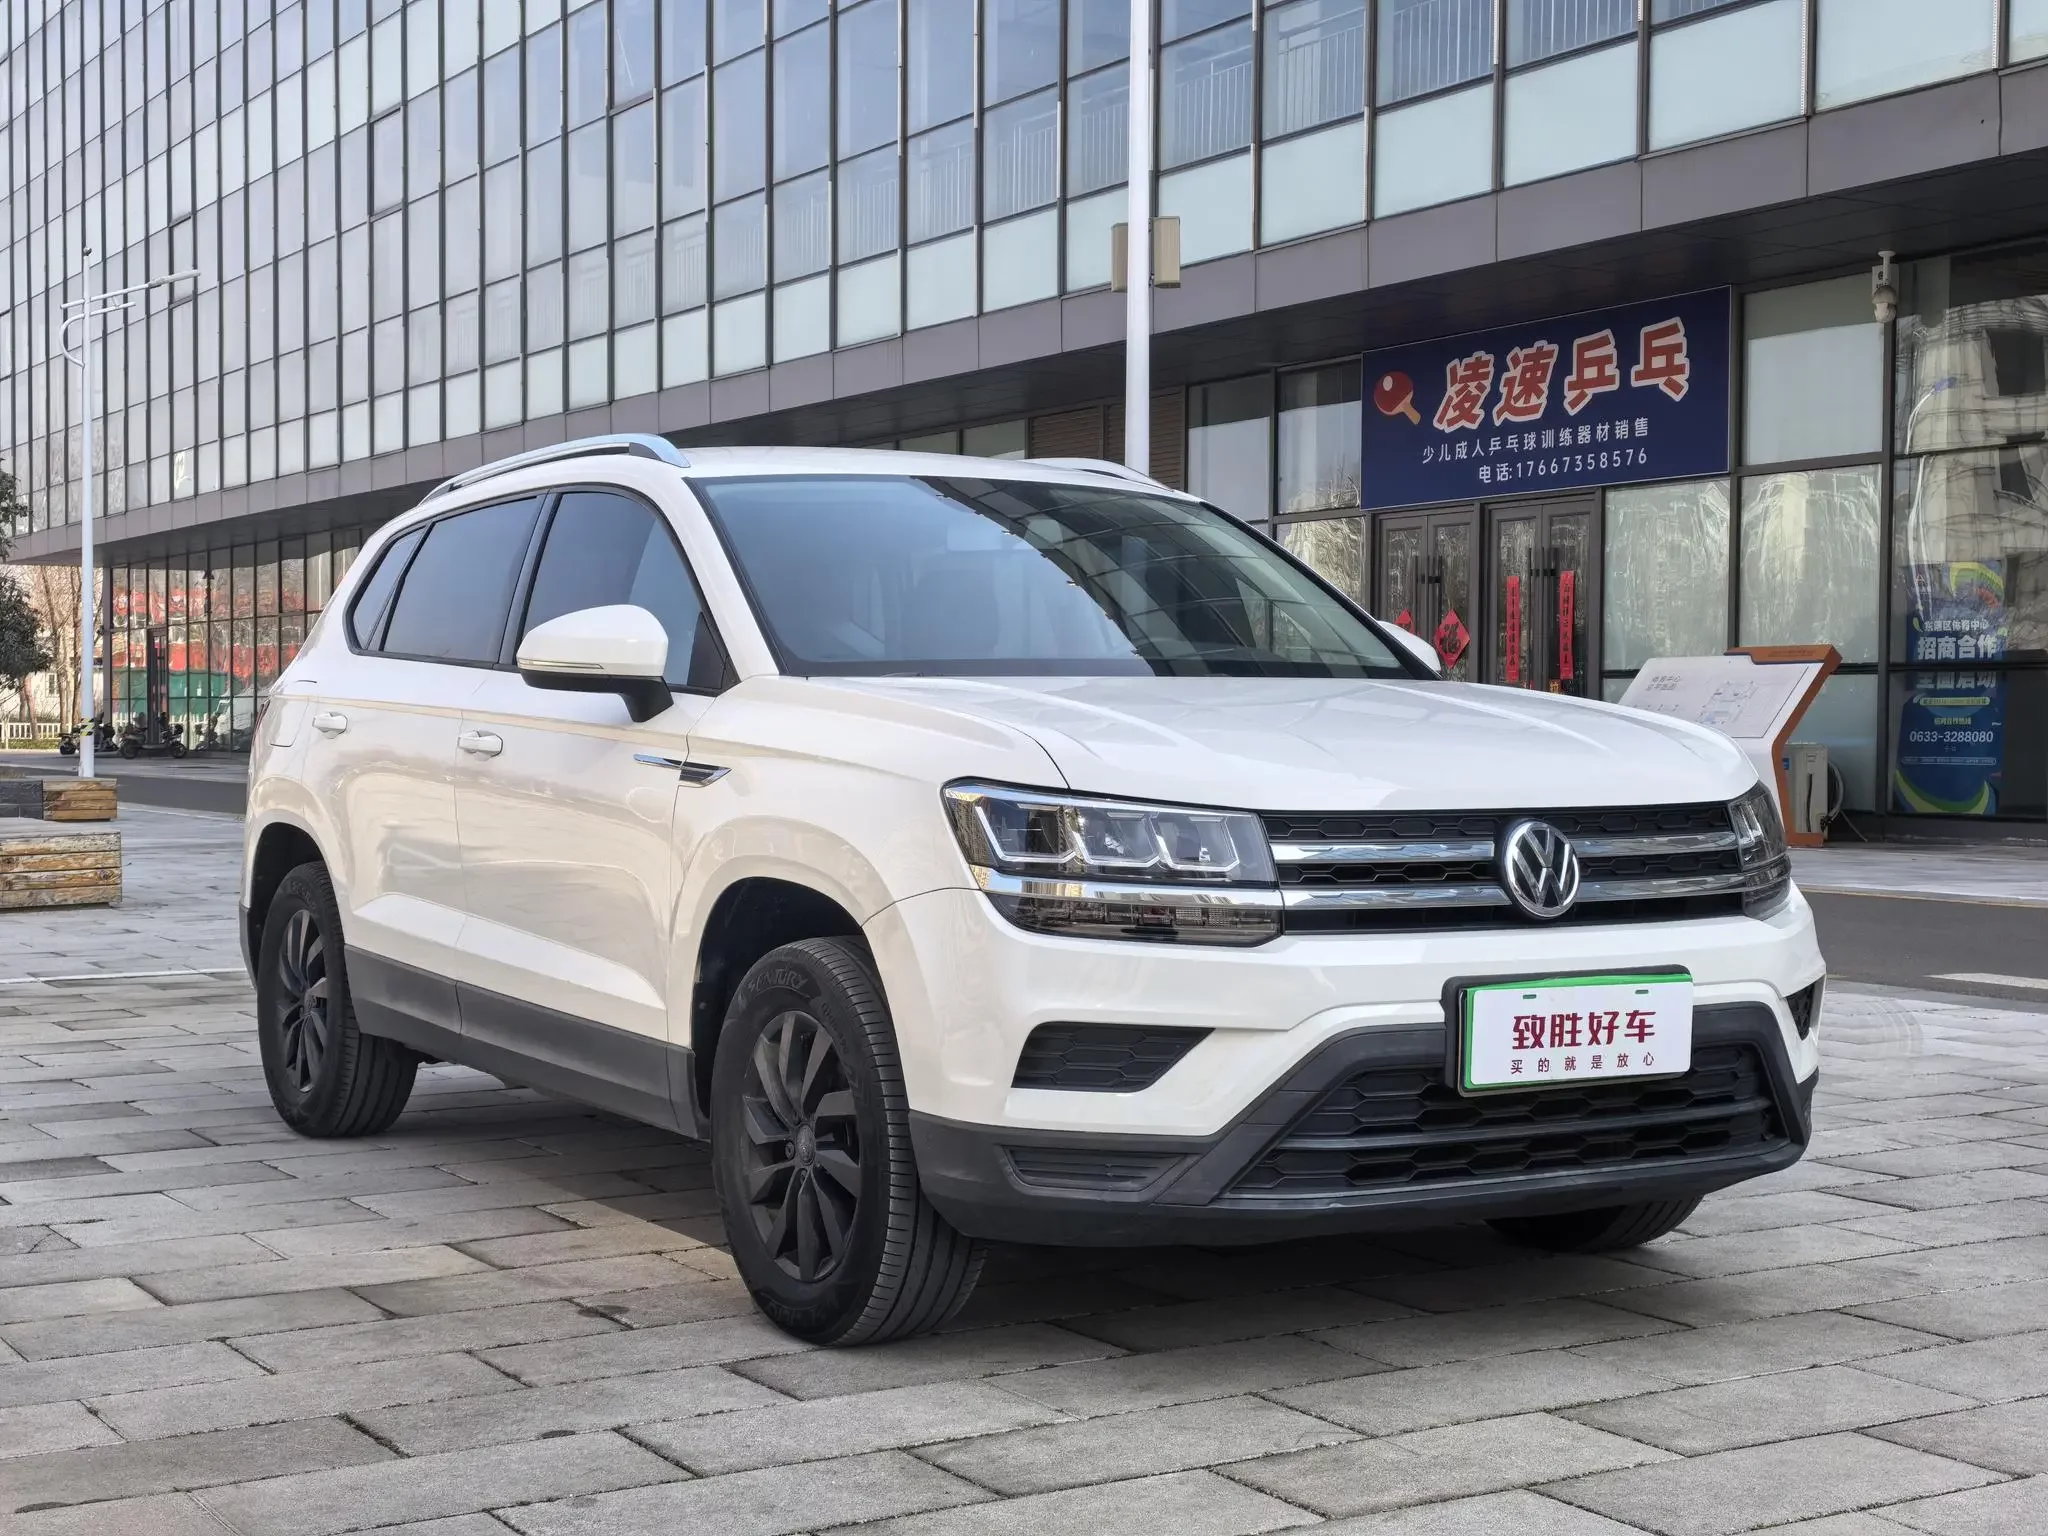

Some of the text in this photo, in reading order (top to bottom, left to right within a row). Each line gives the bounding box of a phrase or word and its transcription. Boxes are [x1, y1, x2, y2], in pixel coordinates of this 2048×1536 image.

[1434, 317, 1689, 433] 凌速乒乓
[1422, 417, 1649, 464] 少儿成人乒乓球训练器材销售
[1917, 634, 1998, 661] 招商合作
[1909, 731, 1994, 743] 0633-3288080
[1512, 1009, 1657, 1050] 致胜好车
[1510, 1052, 1655, 1075] 买的就是放心
